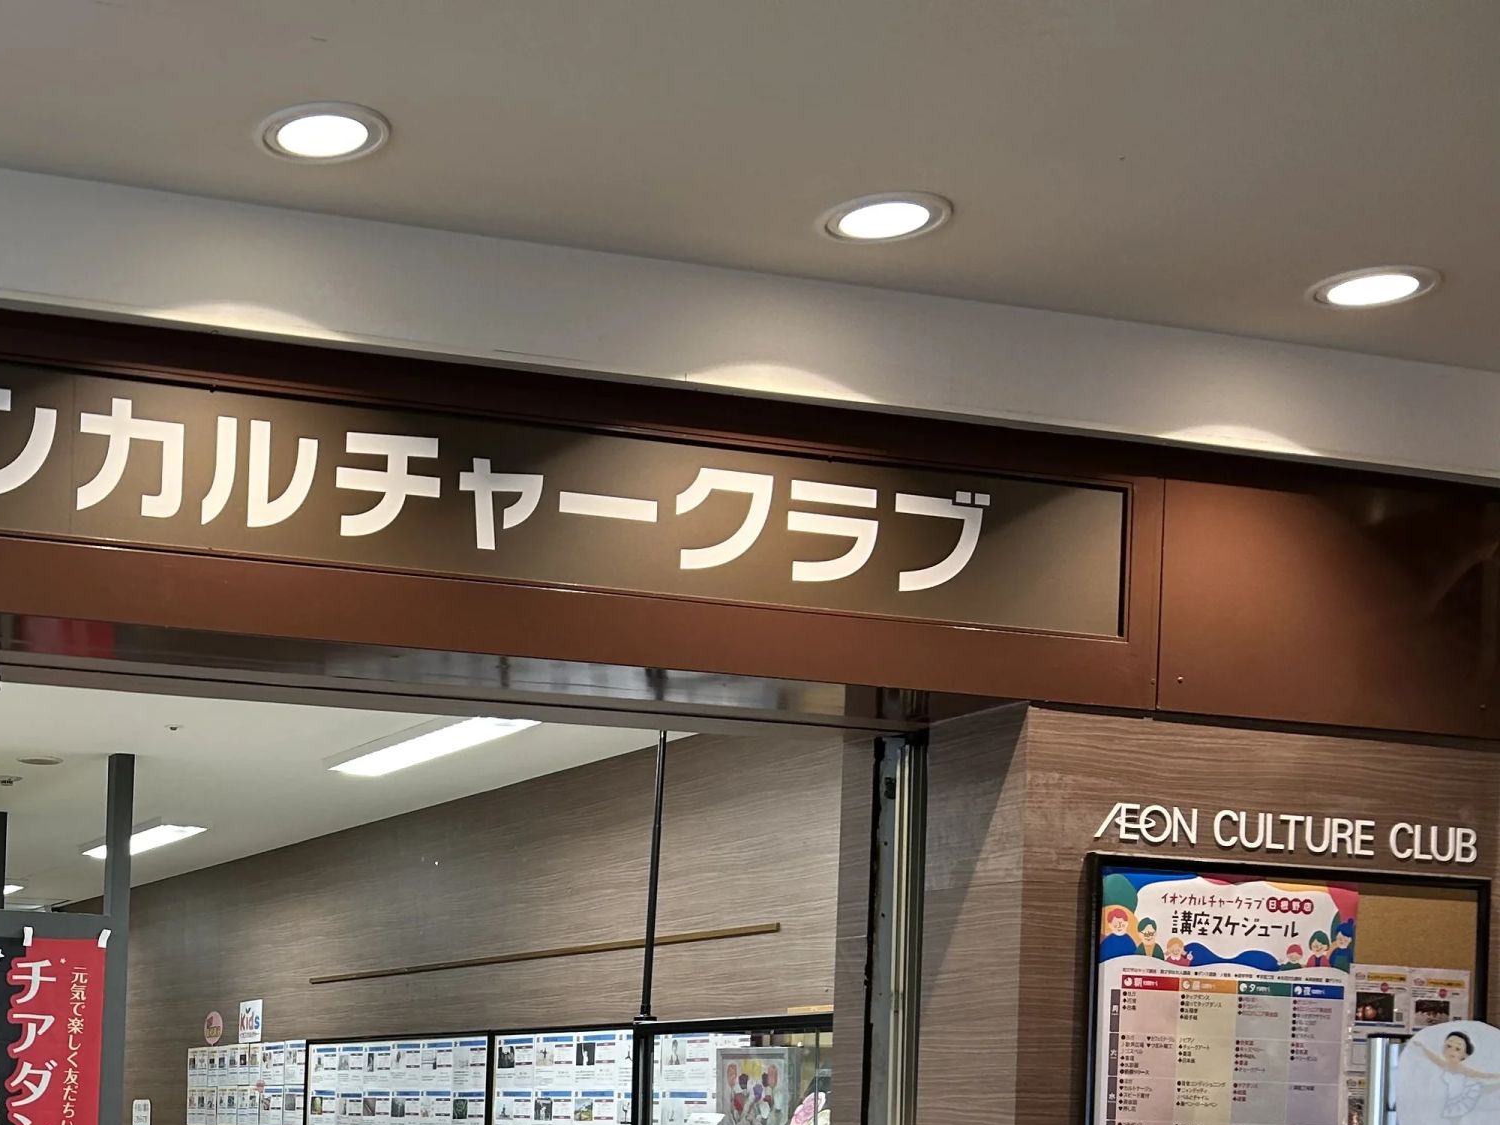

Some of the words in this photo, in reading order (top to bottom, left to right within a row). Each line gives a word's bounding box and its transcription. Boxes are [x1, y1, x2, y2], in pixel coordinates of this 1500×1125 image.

[1213, 809, 1375, 857] CULTURE
[1389, 822, 1478, 864] CLUB
[1161, 892, 1265, 911] イオンカルチャークラブ
[1171, 909, 1299, 939] 講座スケジュール
[240, 1012, 260, 1031] Kids
